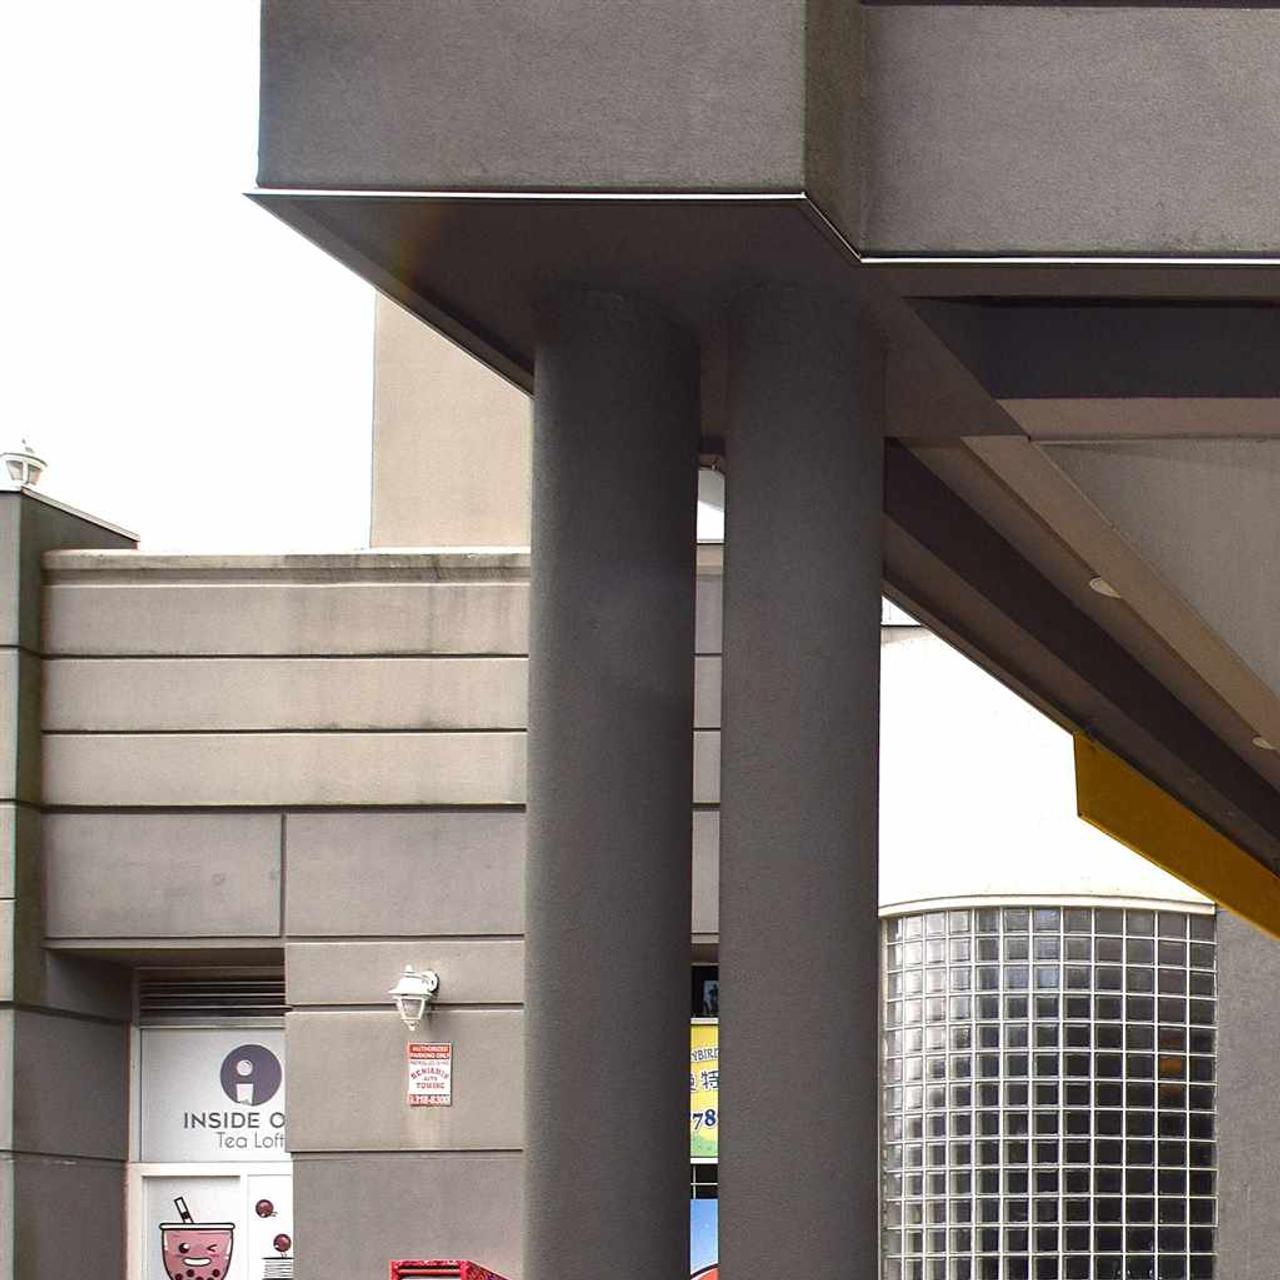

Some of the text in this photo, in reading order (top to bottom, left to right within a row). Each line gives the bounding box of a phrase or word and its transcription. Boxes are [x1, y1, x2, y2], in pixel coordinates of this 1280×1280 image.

[184, 1112, 260, 1128] INSIDE
[216, 1131, 287, 1148] Tea Loft
